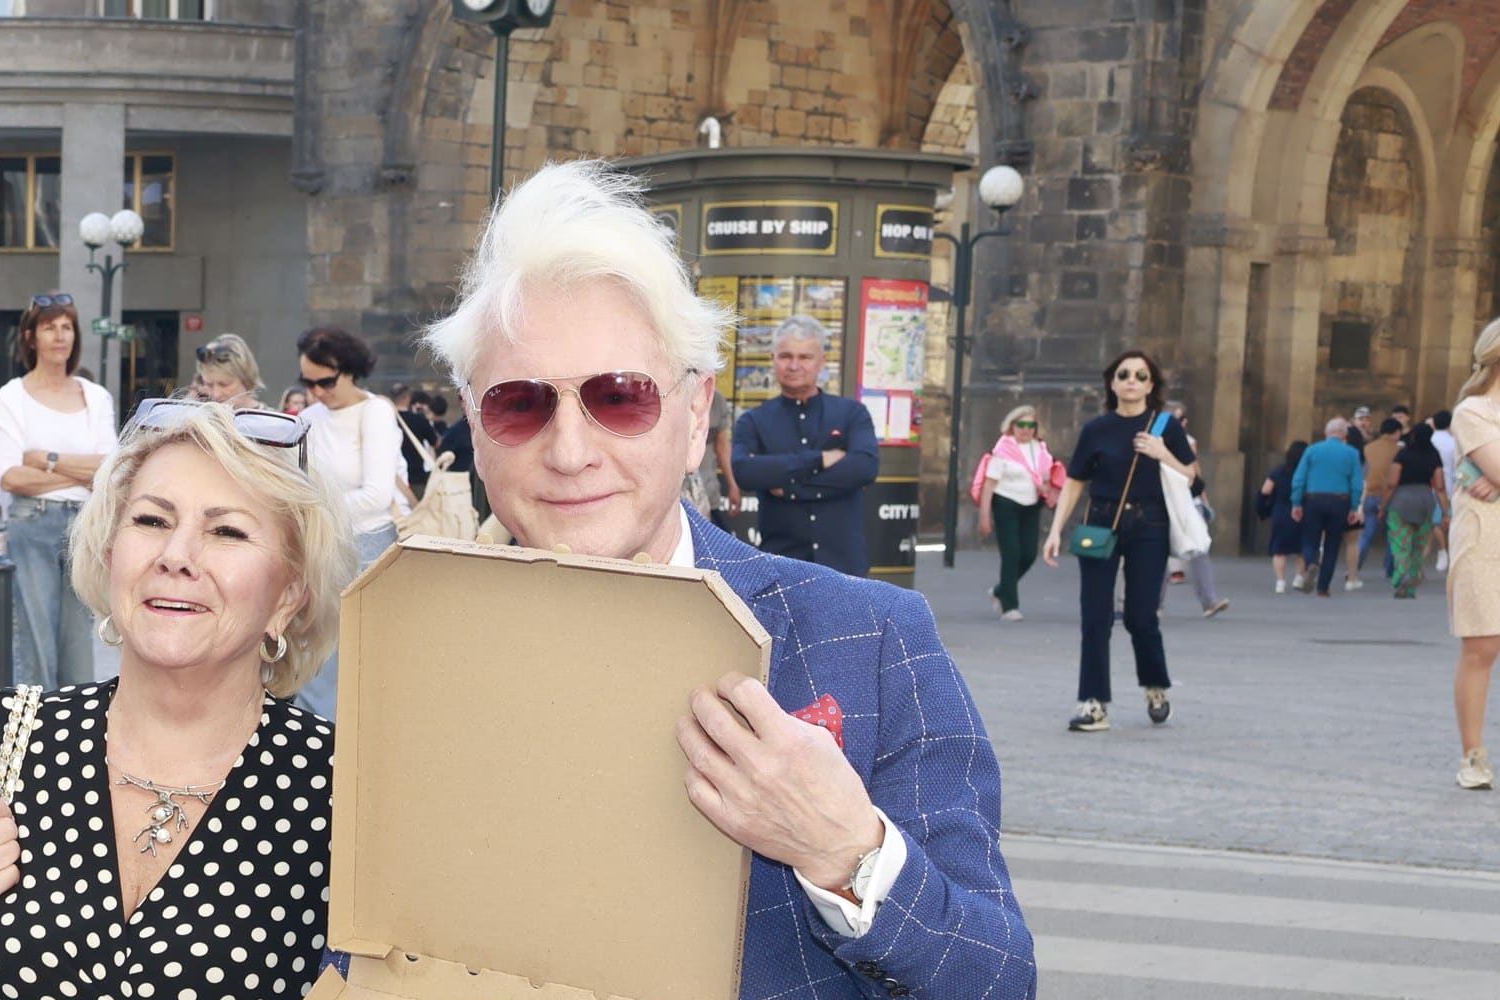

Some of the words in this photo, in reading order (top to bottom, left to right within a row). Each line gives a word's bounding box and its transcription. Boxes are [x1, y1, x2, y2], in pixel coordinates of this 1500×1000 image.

[707, 220, 758, 236] CRUISE
[761, 220, 786, 234] BY
[789, 221, 829, 235] SHIP
[882, 223, 911, 238] HOP
[879, 503, 909, 520] CITY
